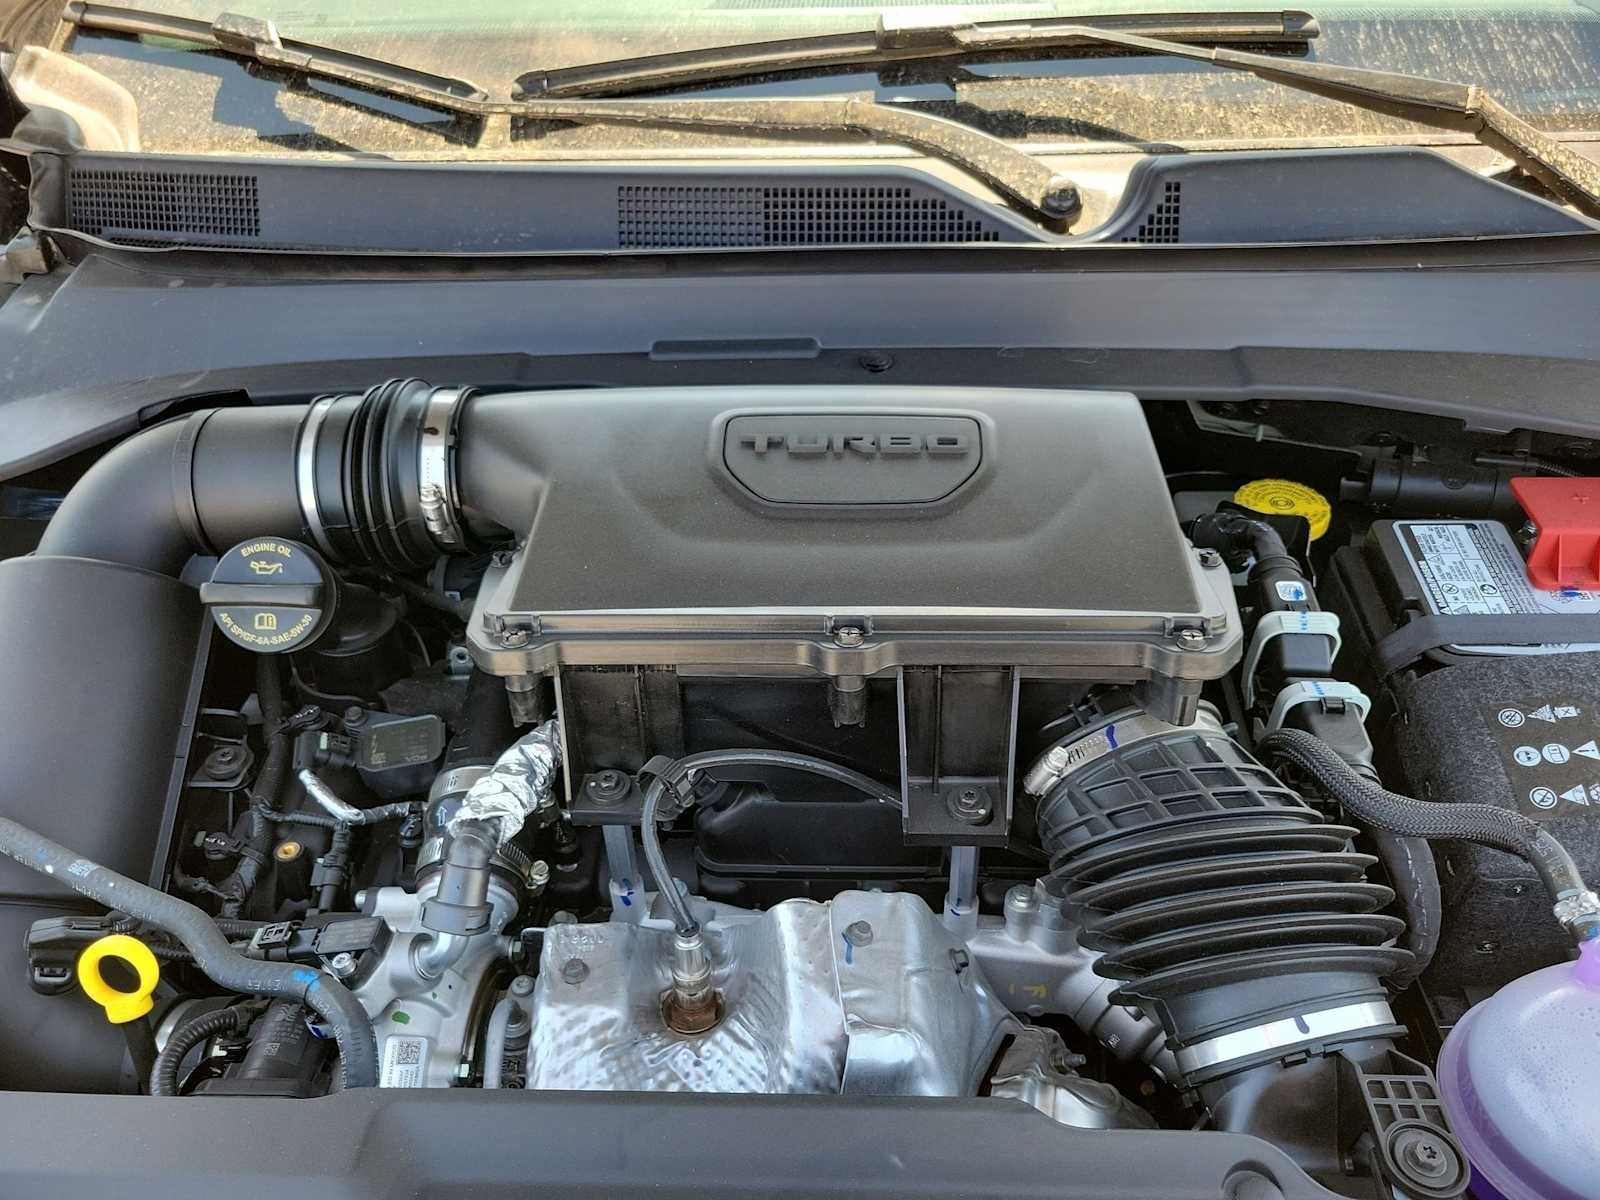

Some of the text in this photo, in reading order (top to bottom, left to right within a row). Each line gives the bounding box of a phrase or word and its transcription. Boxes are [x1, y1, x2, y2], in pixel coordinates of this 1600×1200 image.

[739, 432, 968, 455] TURBO
[241, 543, 291, 558] ENGINE OIL
[219, 613, 234, 628] API
